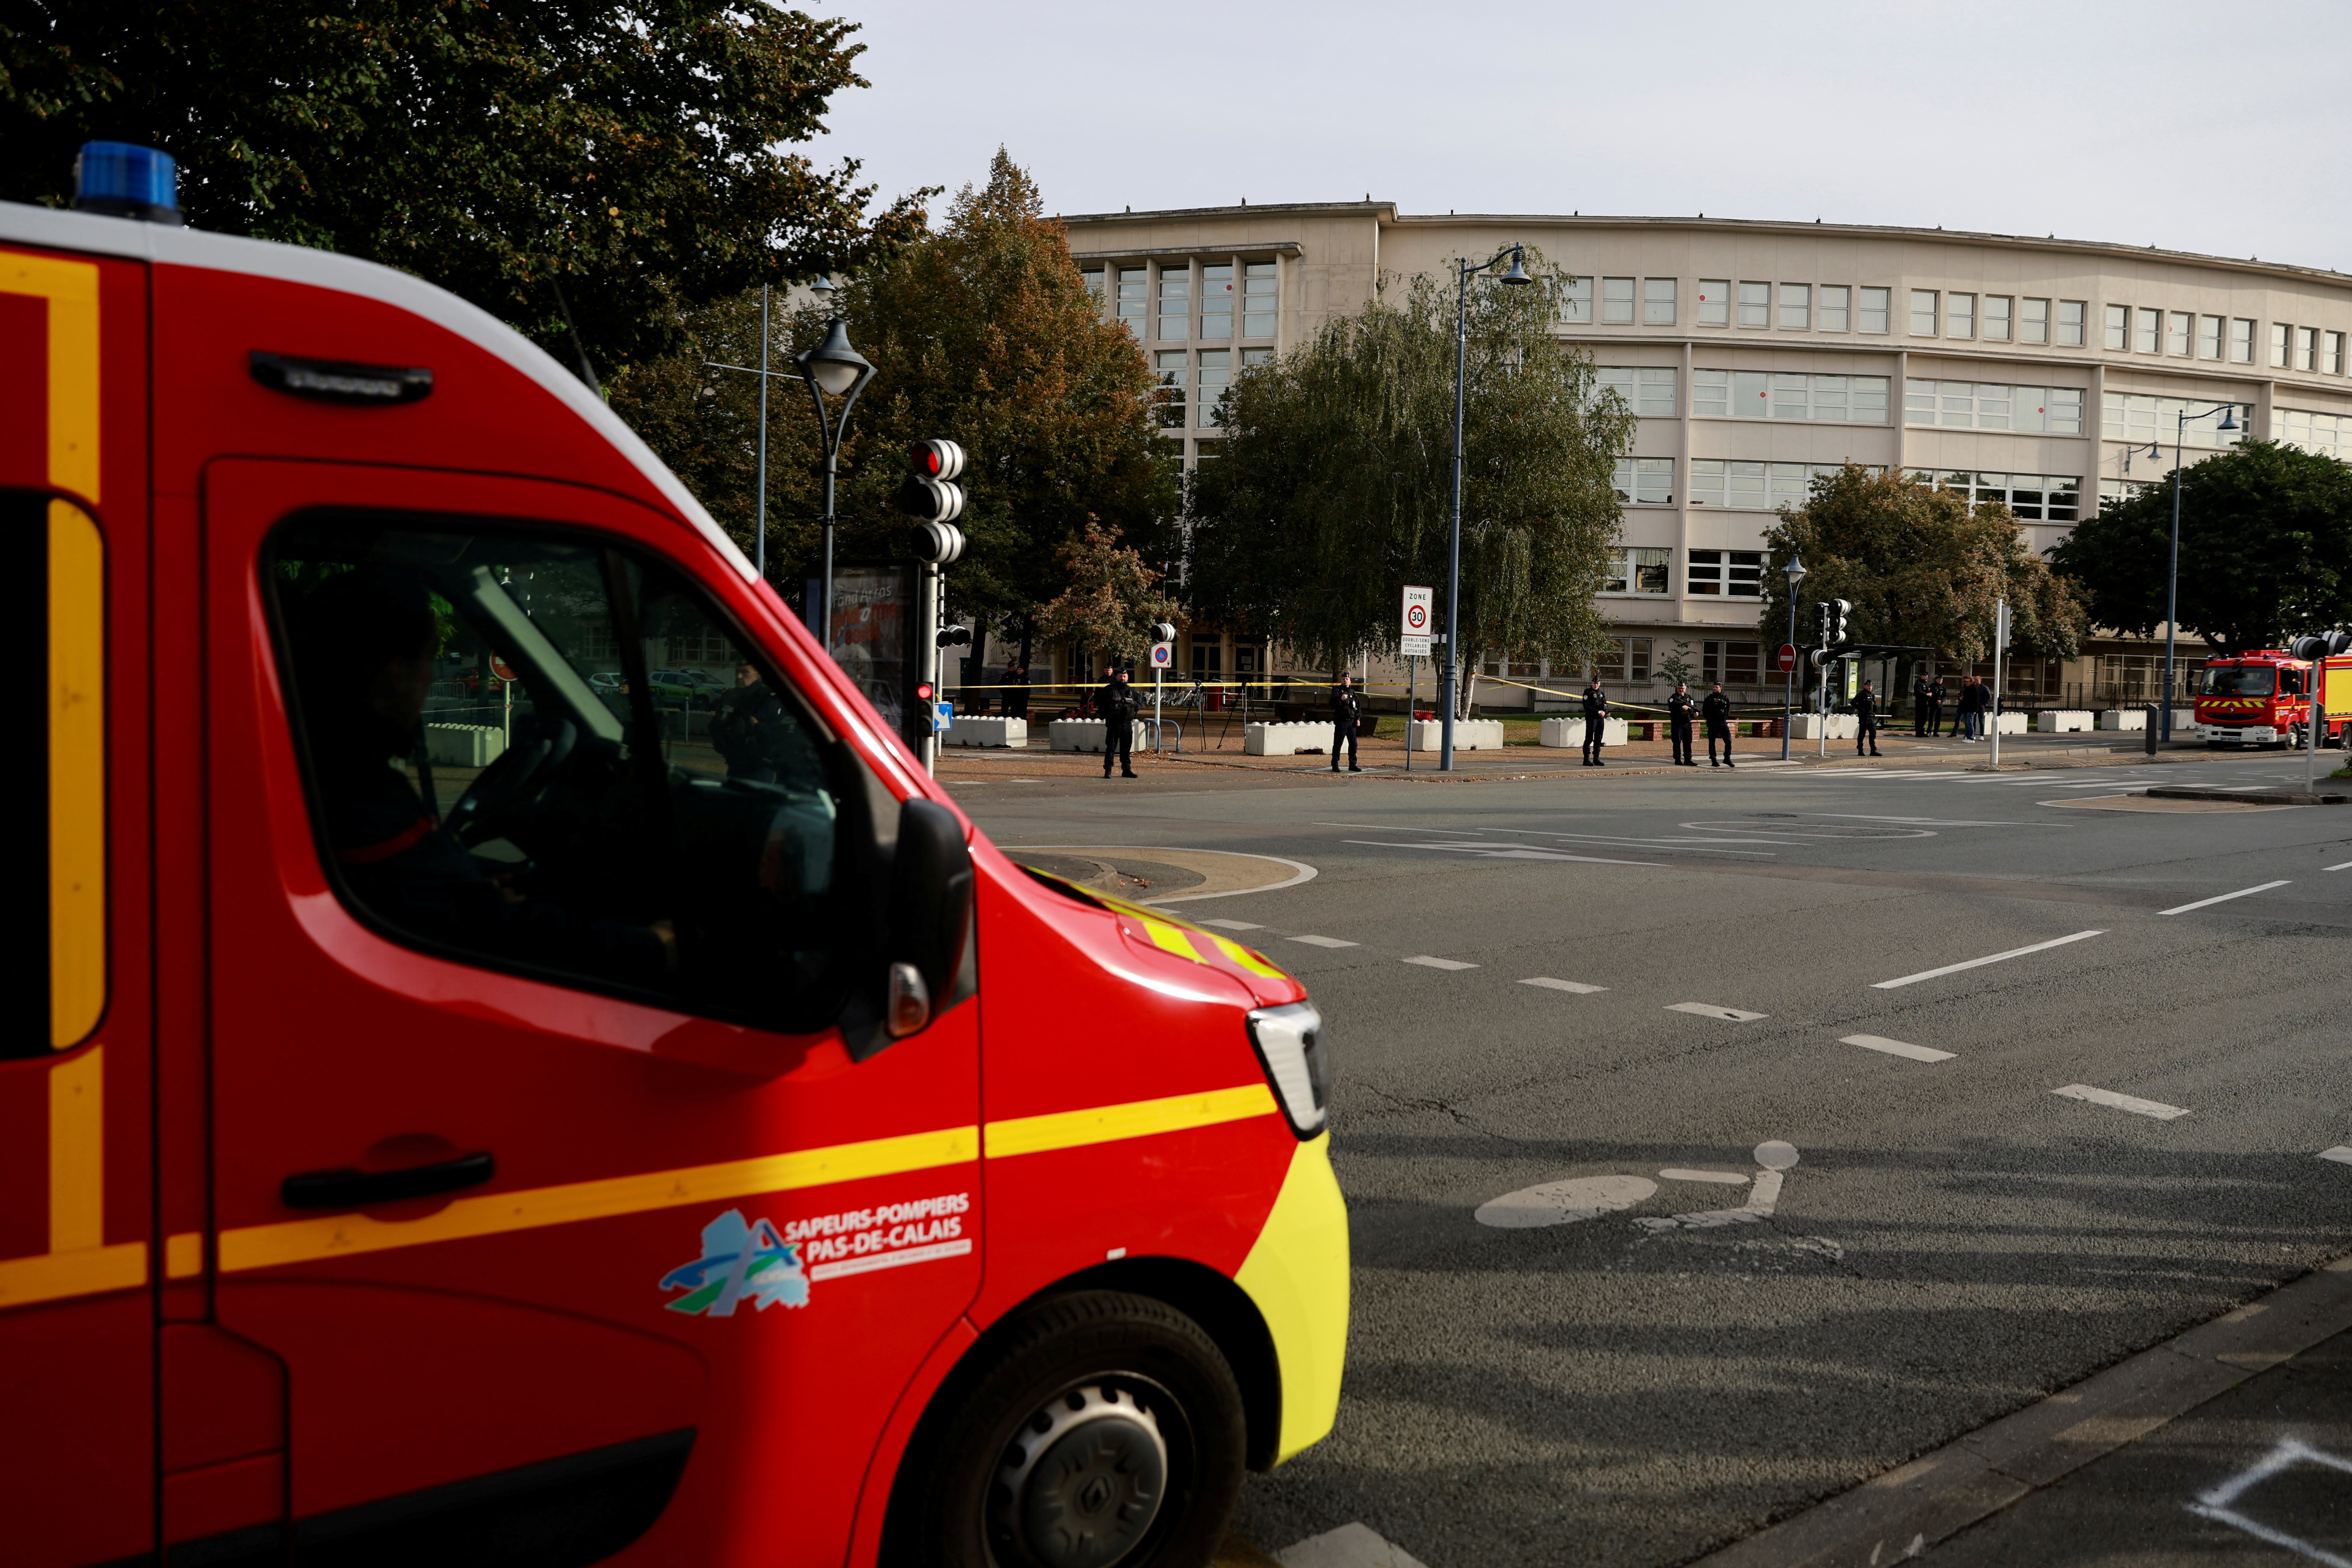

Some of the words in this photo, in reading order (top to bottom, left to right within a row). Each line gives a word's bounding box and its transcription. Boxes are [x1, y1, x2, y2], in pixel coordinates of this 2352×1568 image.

[832, 590, 858, 608] rand
[860, 586, 892, 606] Arras
[1412, 612, 1422, 621] 30
[785, 1193, 969, 1242] SAPEURS-POMPIERS
[806, 1217, 962, 1263] PAS-DE-CALAIS
